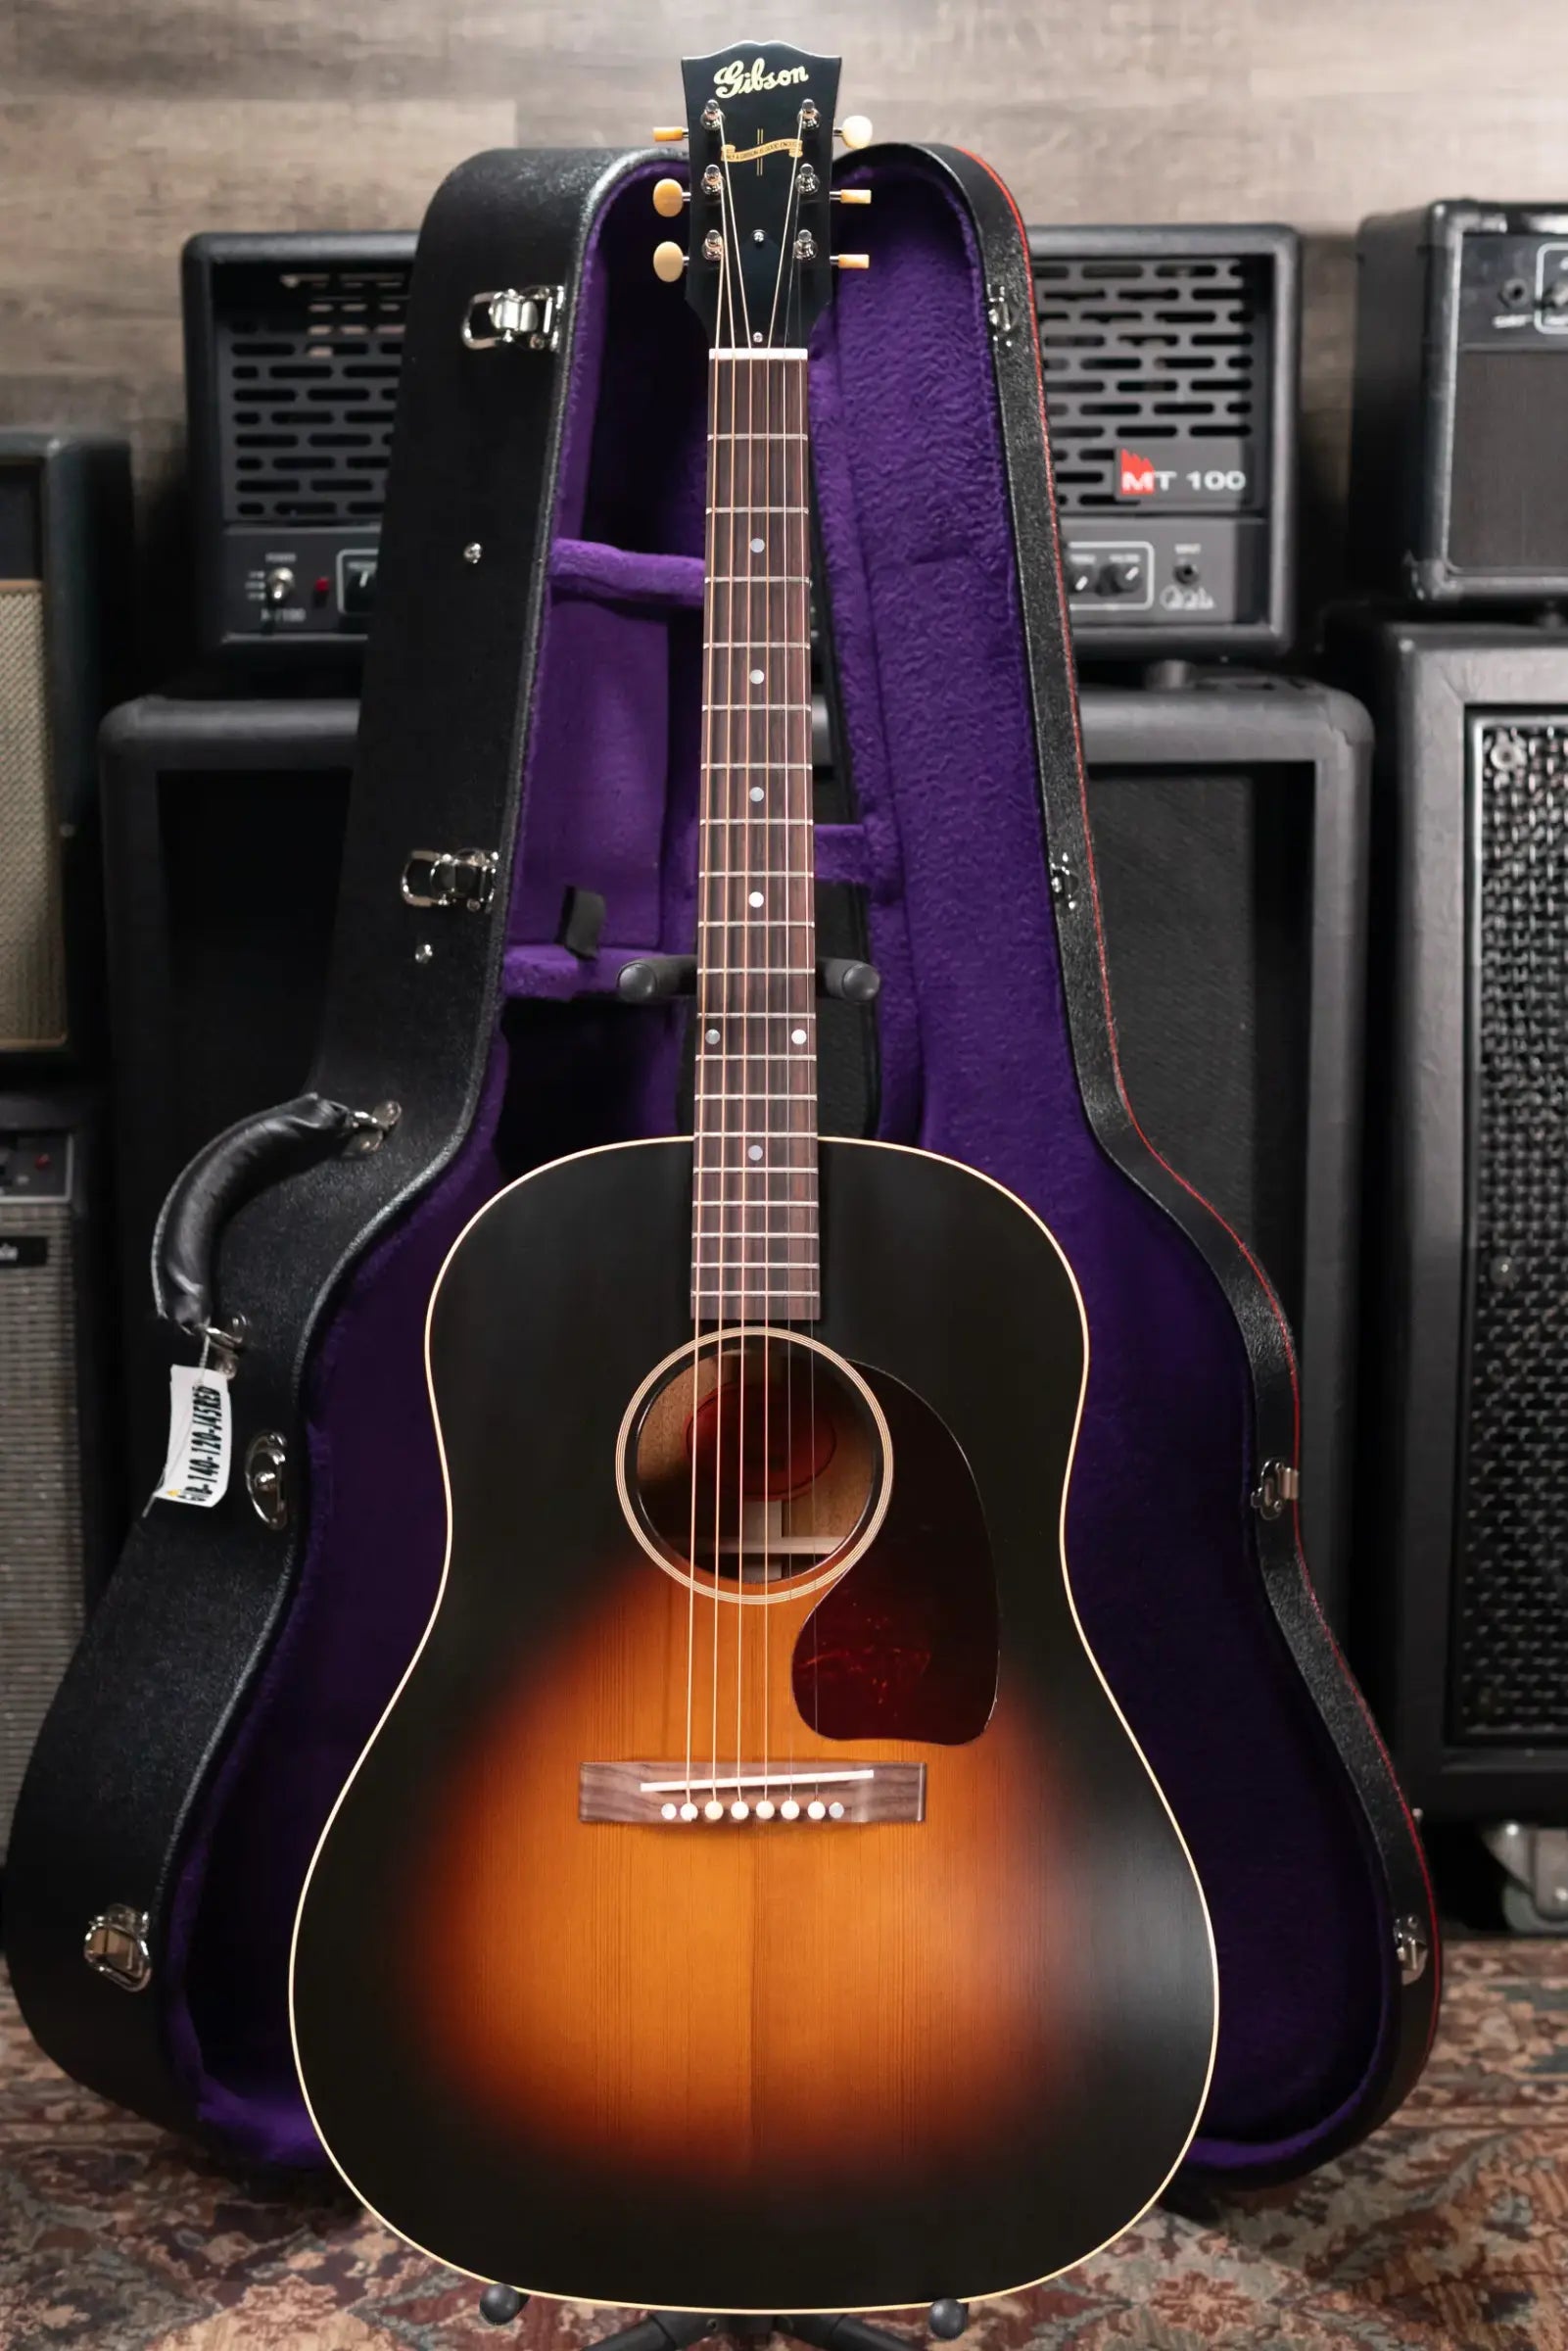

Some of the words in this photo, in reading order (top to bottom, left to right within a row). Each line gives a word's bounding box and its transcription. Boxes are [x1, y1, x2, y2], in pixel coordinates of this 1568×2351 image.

[713, 57, 809, 99] Gibson
[1121, 471, 1177, 491] MT
[1186, 470, 1247, 491] 100
